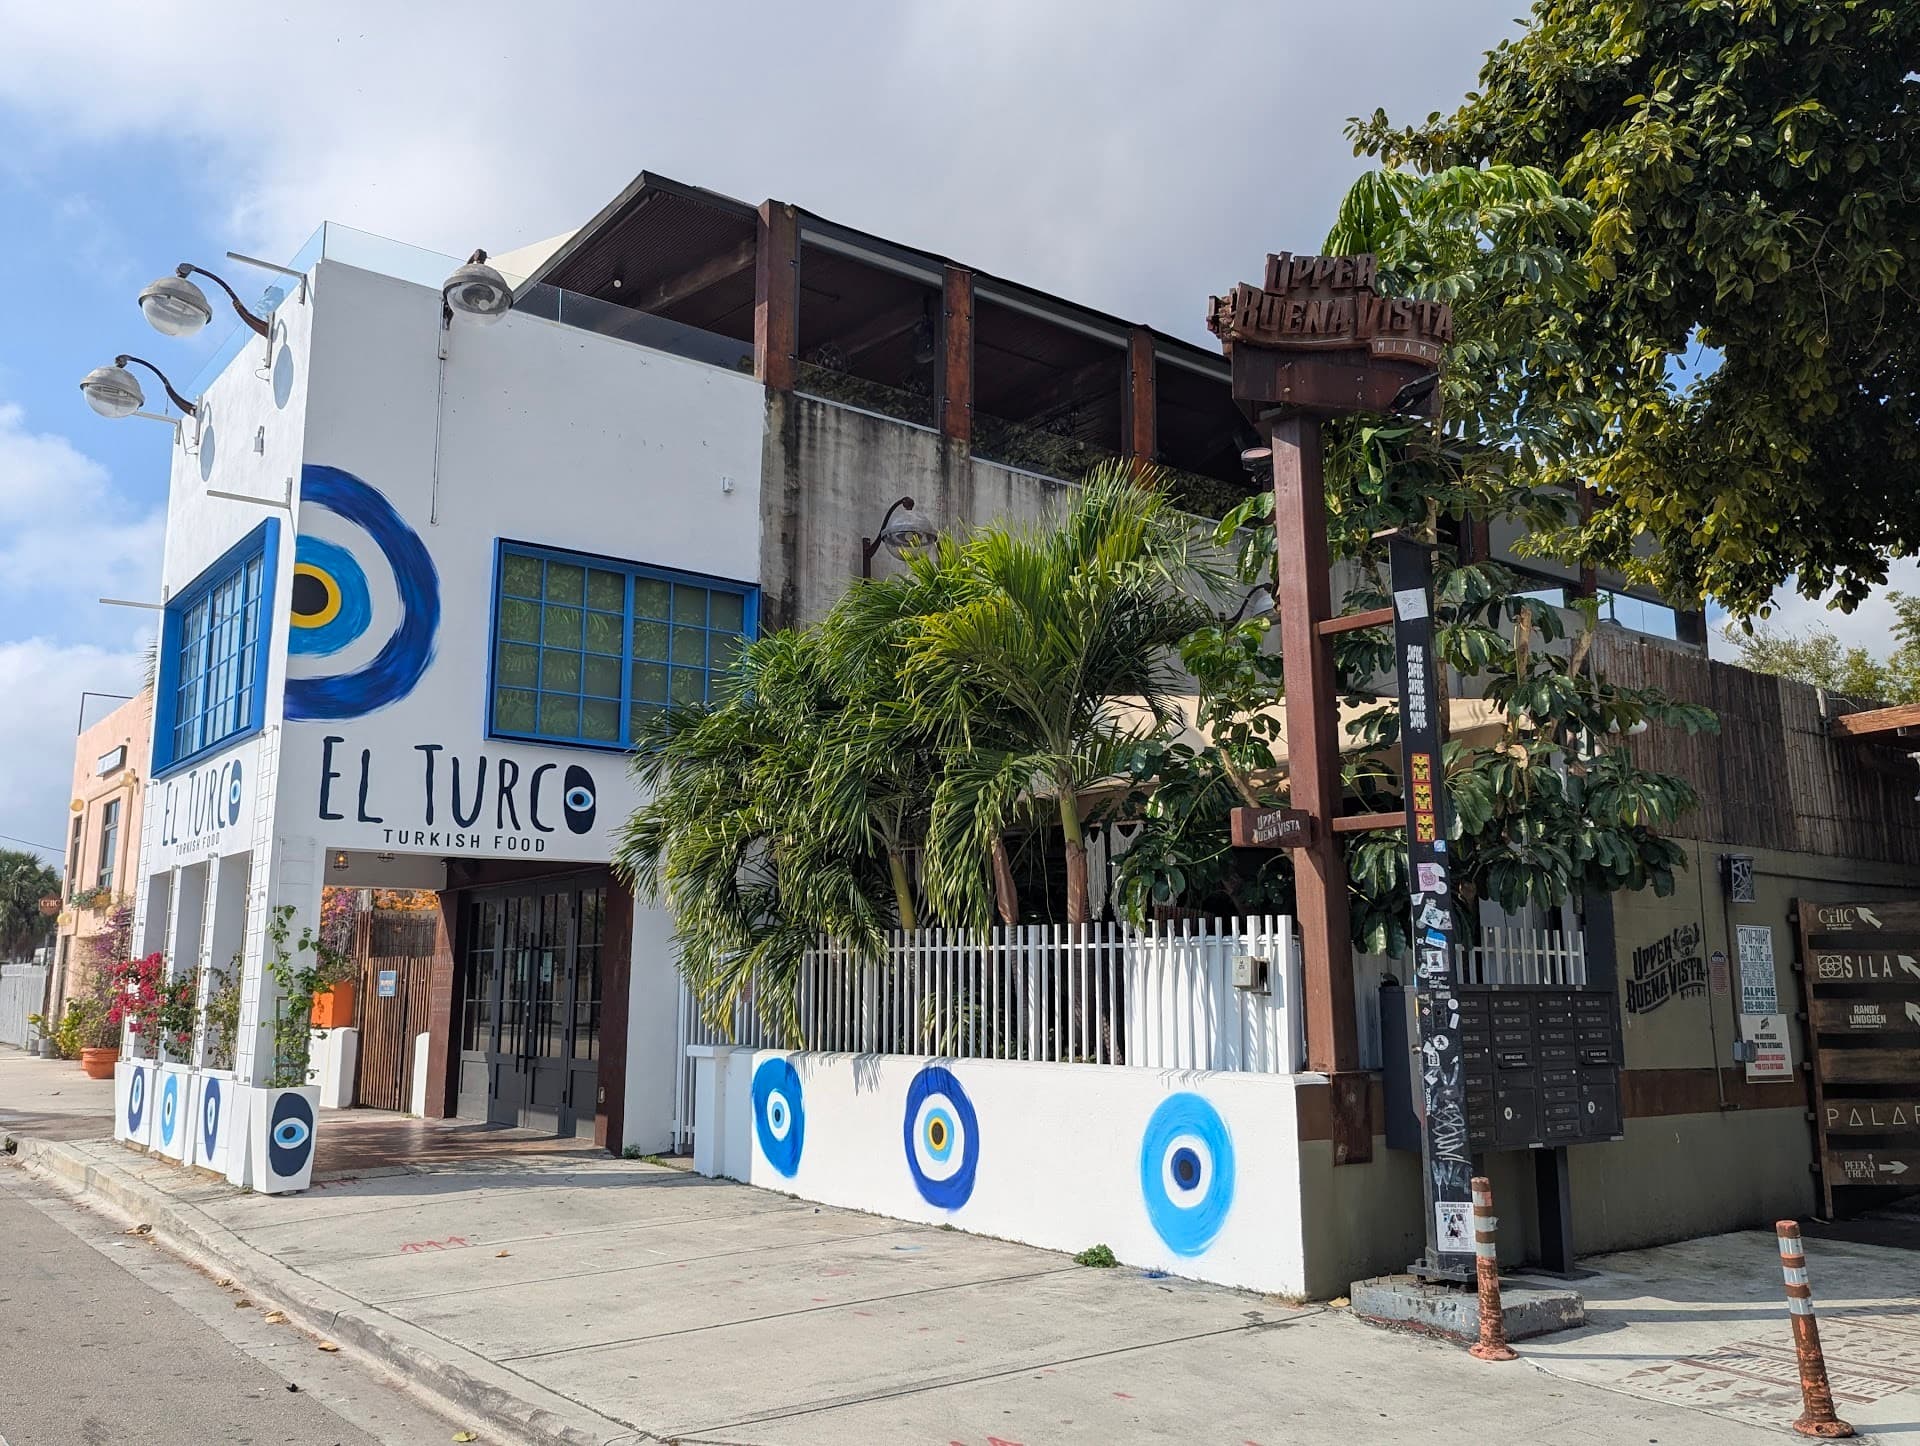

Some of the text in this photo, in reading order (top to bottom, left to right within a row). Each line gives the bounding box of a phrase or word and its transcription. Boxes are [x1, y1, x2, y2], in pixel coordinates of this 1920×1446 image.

[1264, 251, 1377, 296] UPPER
[1235, 282, 1456, 343] BUENA VISTA
[1377, 341, 1438, 361] MIAMI
[319, 736, 596, 835] EL TURCO
[162, 759, 243, 846] EL TURCO
[1257, 810, 1281, 829] UPPER
[1278, 820, 1300, 837] VISTA
[175, 832, 221, 856] TURKISH FOOD
[383, 829, 546, 852] TURKISH FOOD
[1632, 935, 1675, 980] UPPER
[1749, 945, 1764, 961] ZONE
[1844, 955, 1893, 978] SILA
[1626, 972, 1668, 1013] BUENA
[1668, 958, 1706, 995] VISTA
[1744, 987, 1776, 996] ALPINE
[1849, 1014, 1887, 1024] LINDGREN
[1853, 1005, 1880, 1014] RANDY
[1844, 1160, 1867, 1171] PEEK
[1847, 1170, 1876, 1179] TREAT
